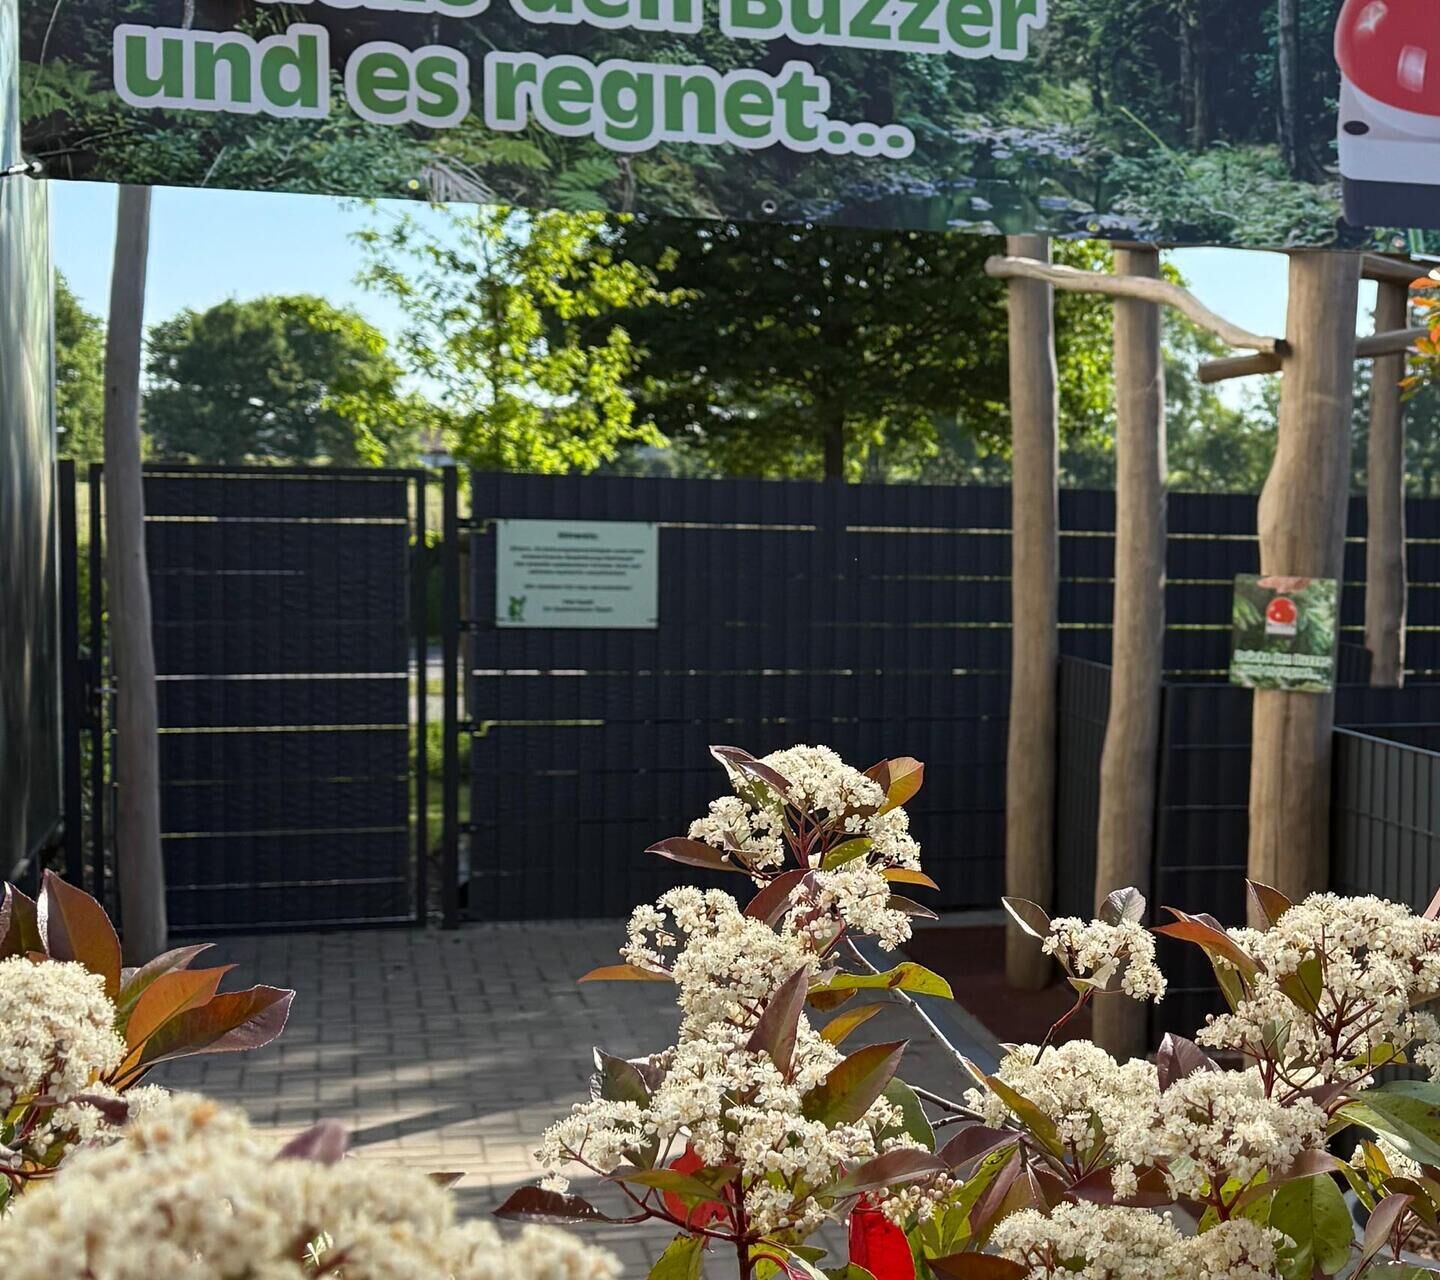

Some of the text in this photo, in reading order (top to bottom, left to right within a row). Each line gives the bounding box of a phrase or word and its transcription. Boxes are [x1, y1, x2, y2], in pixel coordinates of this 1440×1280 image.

[113, 24, 915, 159] und es regnet...
